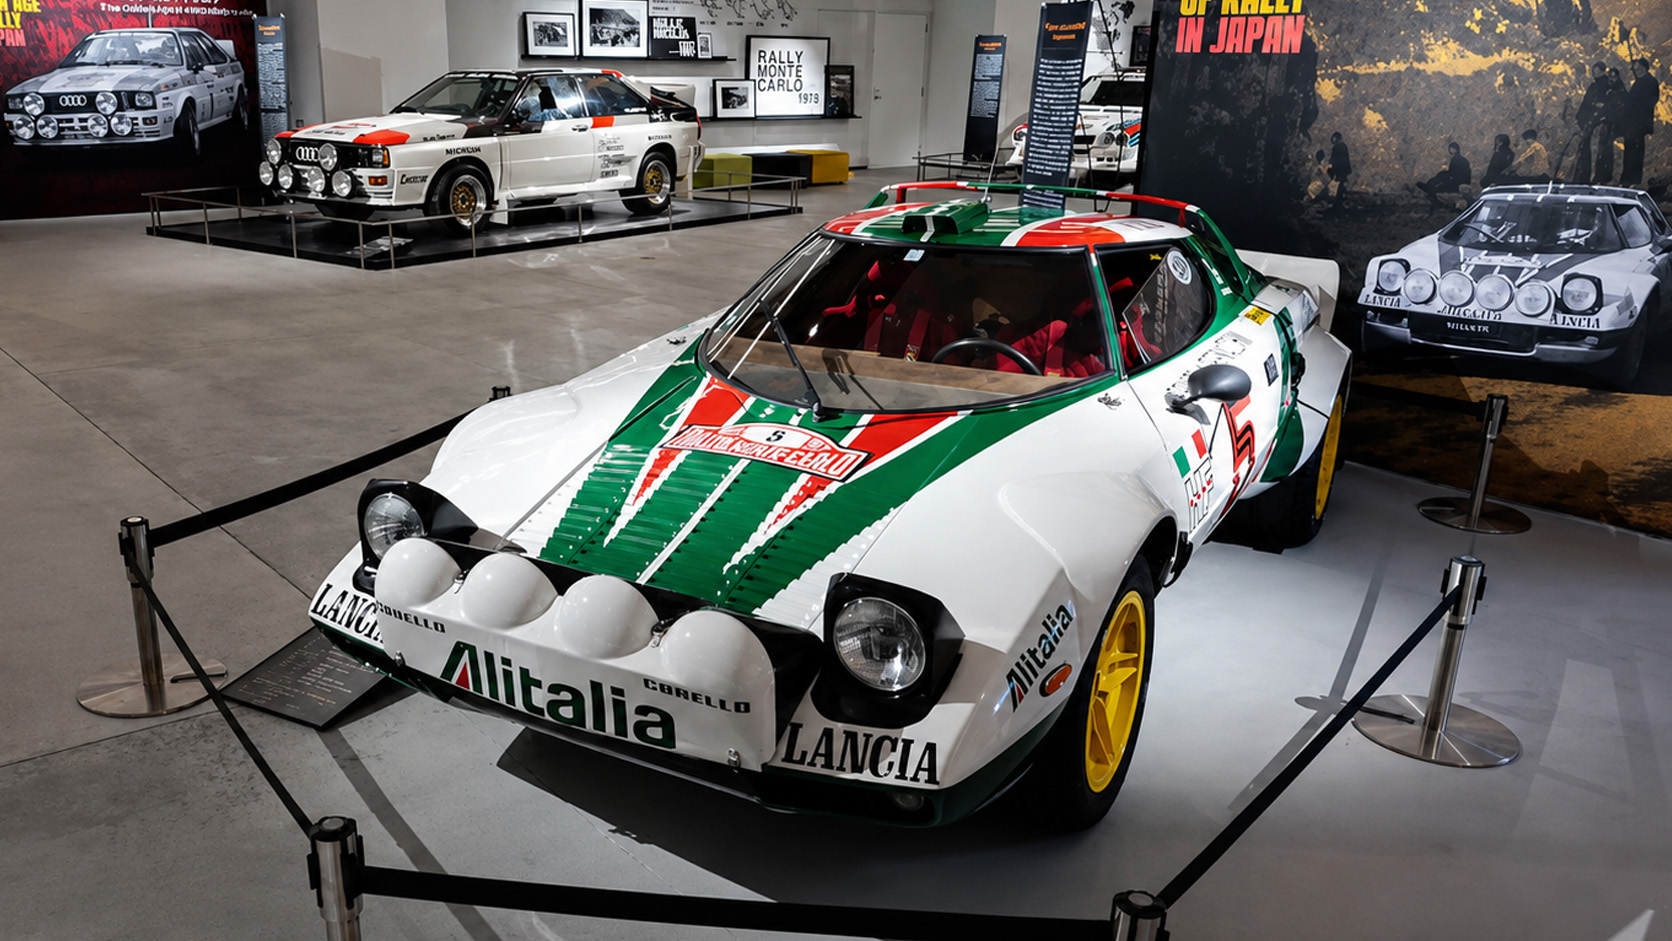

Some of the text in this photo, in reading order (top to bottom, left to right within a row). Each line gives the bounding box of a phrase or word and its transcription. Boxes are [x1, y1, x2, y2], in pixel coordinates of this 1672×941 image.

[1175, 15, 1306, 53] IN JAPAN
[758, 50, 803, 63] RALLY
[758, 64, 802, 78] MONTE
[758, 79, 803, 92] CARLO
[766, 430, 786, 442] 5
[310, 583, 384, 644] LANCI
[1006, 604, 1073, 712] Alitalia
[440, 640, 676, 750] Alitalia
[781, 722, 940, 785] LANCIA
